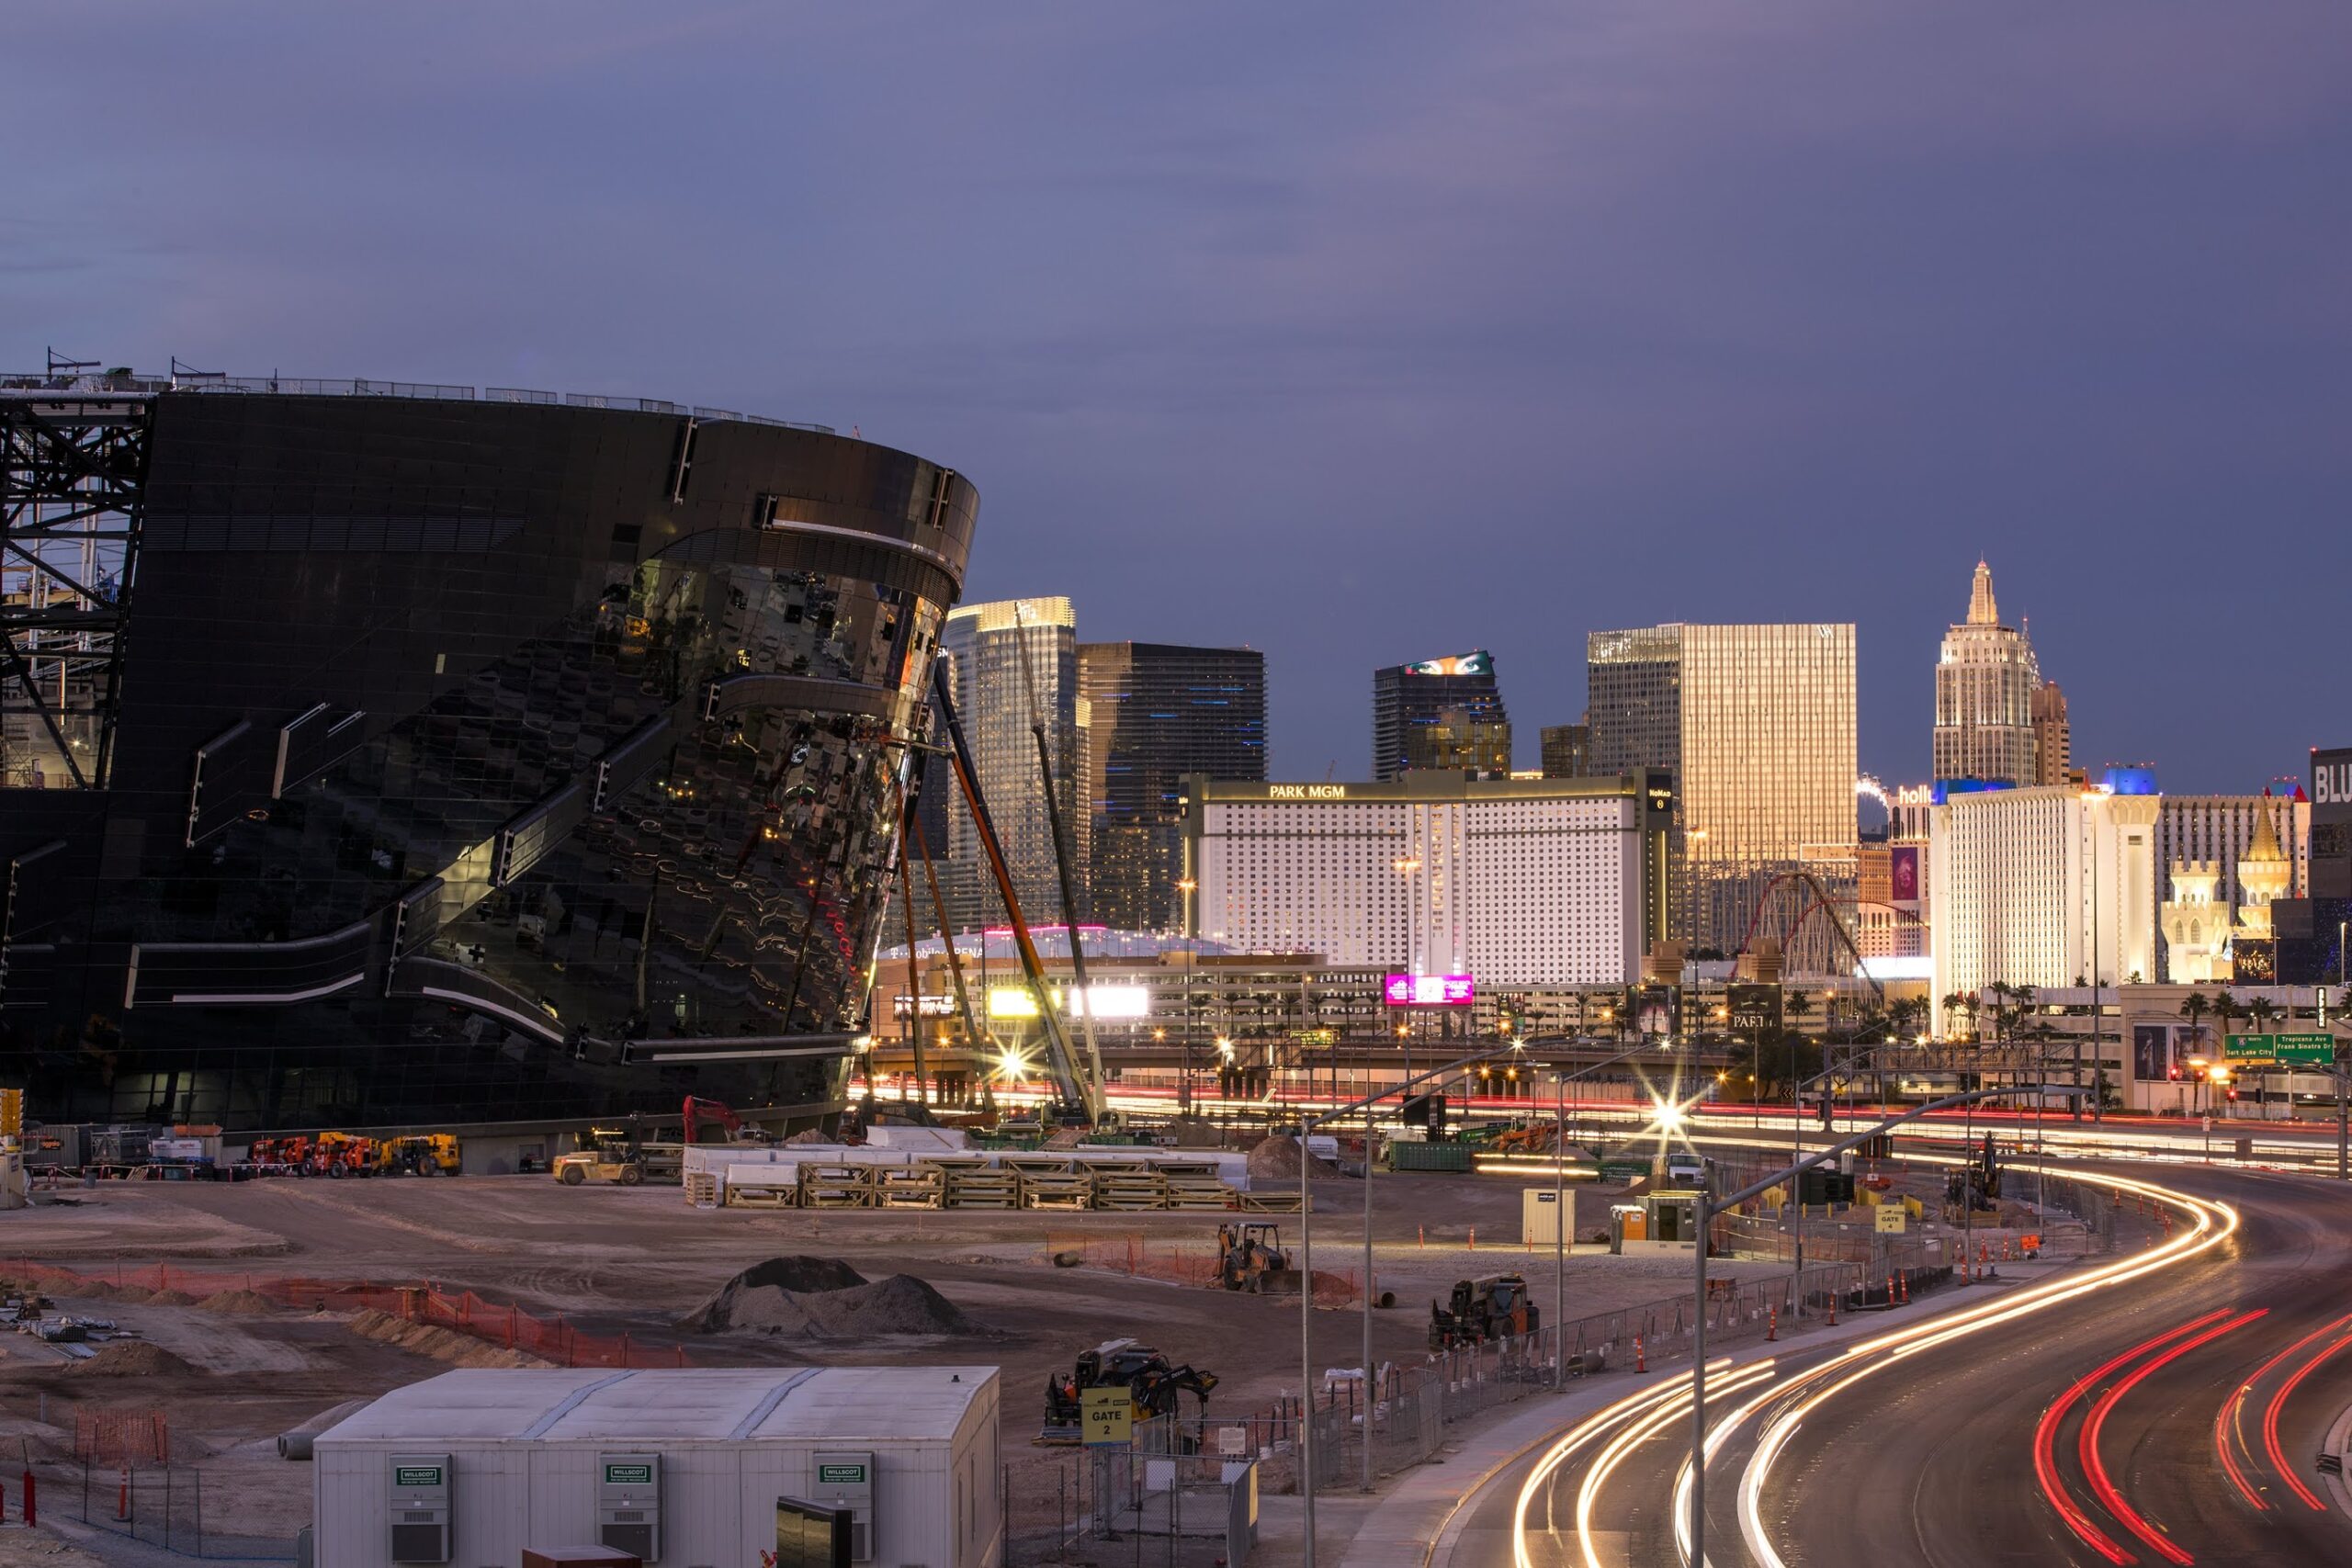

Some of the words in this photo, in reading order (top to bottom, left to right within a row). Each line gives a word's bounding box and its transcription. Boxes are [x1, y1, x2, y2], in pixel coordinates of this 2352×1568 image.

[1270, 785, 1305, 798] PARK
[1308, 785, 1345, 798] MGM
[1092, 1411, 1122, 1421] GATE
[1104, 1425, 1110, 1434] 2
